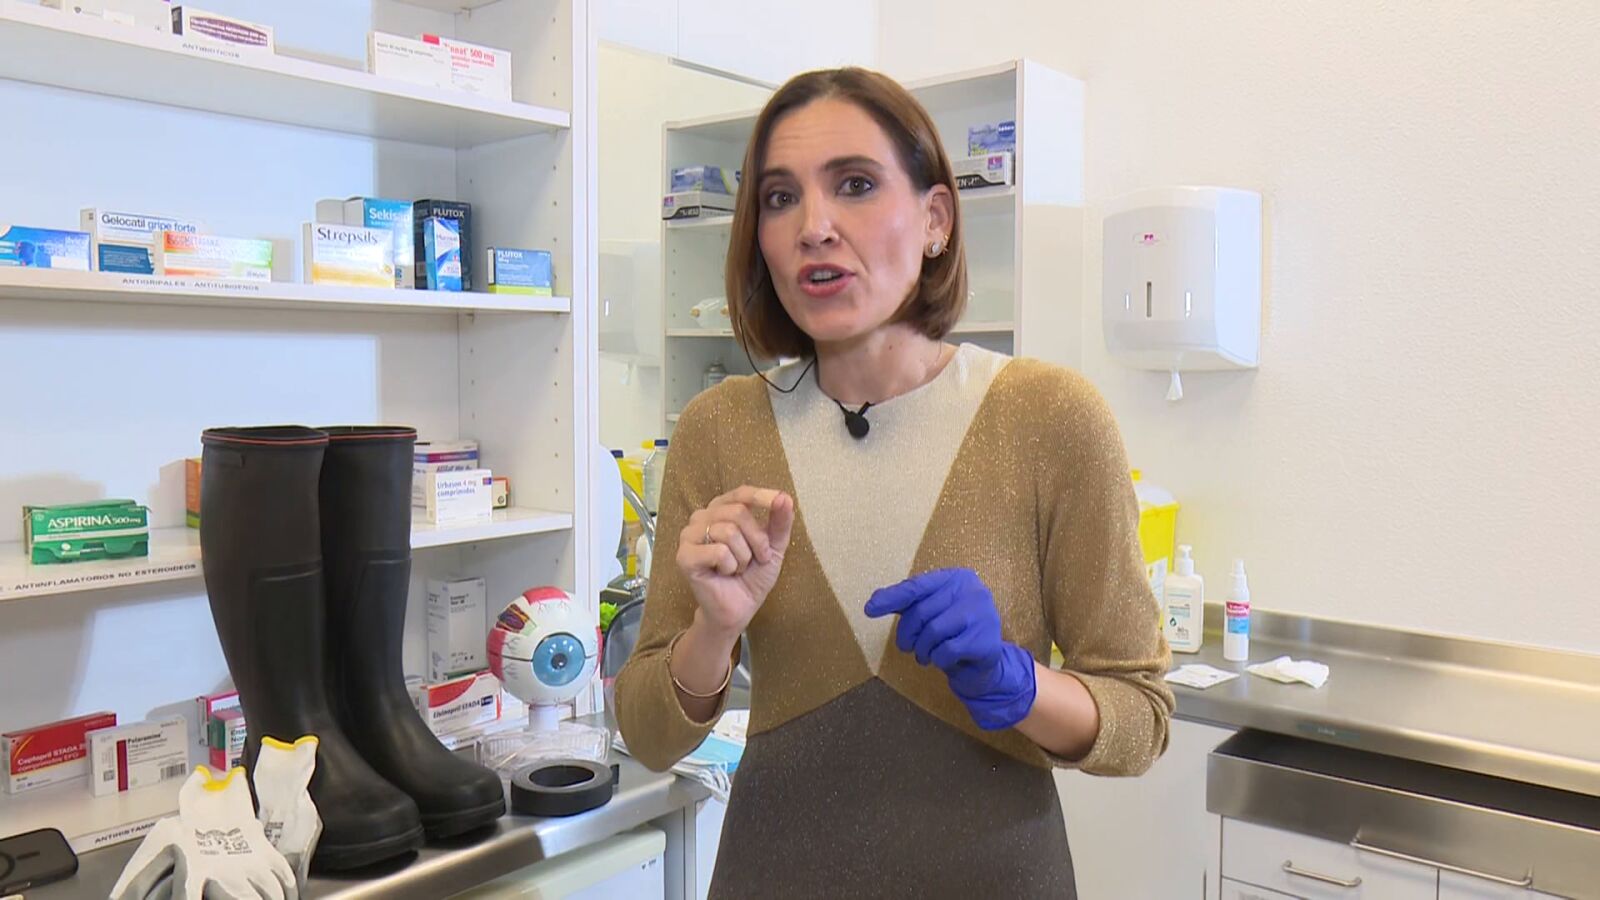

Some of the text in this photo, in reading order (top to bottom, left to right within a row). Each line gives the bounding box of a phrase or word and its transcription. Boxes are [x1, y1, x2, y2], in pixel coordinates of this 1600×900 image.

[470, 48, 482, 59] 500
[483, 52, 495, 62] mg
[433, 207, 465, 219] FLUTOX
[101, 213, 197, 233] Gelocatil gripe forte
[317, 227, 378, 245] Strepsils
[497, 250, 523, 259] FLUTOX
[48, 515, 112, 529] ASPIRINA
[135, 563, 197, 576] ESTEROIDEOS
[17, 751, 52, 766] Captopril
[53, 745, 78, 757] STADA
